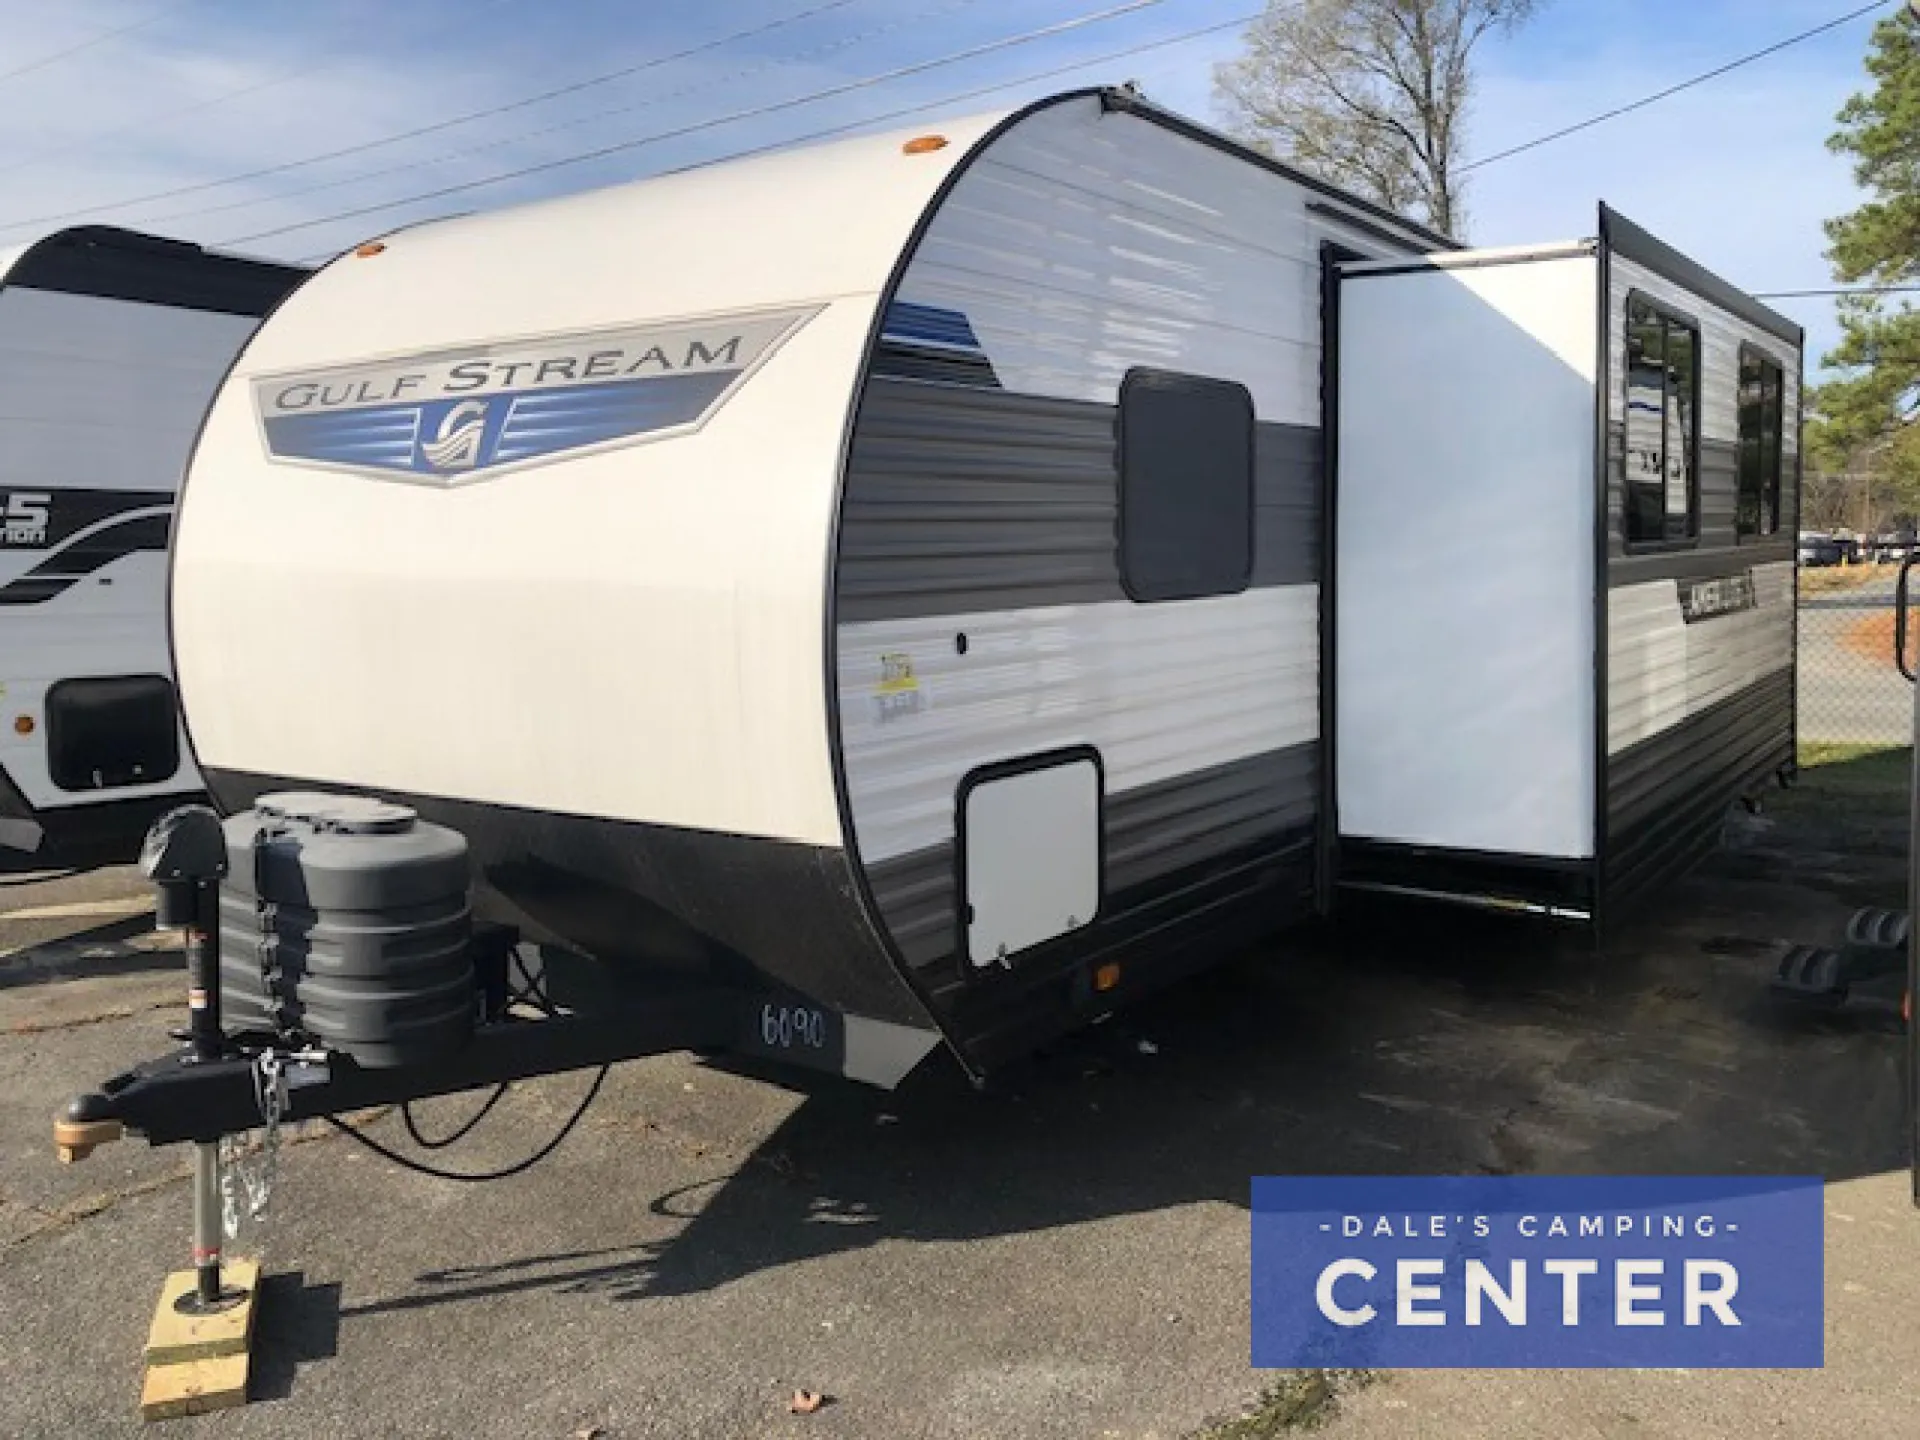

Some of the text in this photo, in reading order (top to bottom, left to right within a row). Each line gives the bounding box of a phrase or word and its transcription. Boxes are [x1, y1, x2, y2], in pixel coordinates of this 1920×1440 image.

[276, 335, 743, 408] GULF STREAM
[761, 1004, 823, 1048] 6090
